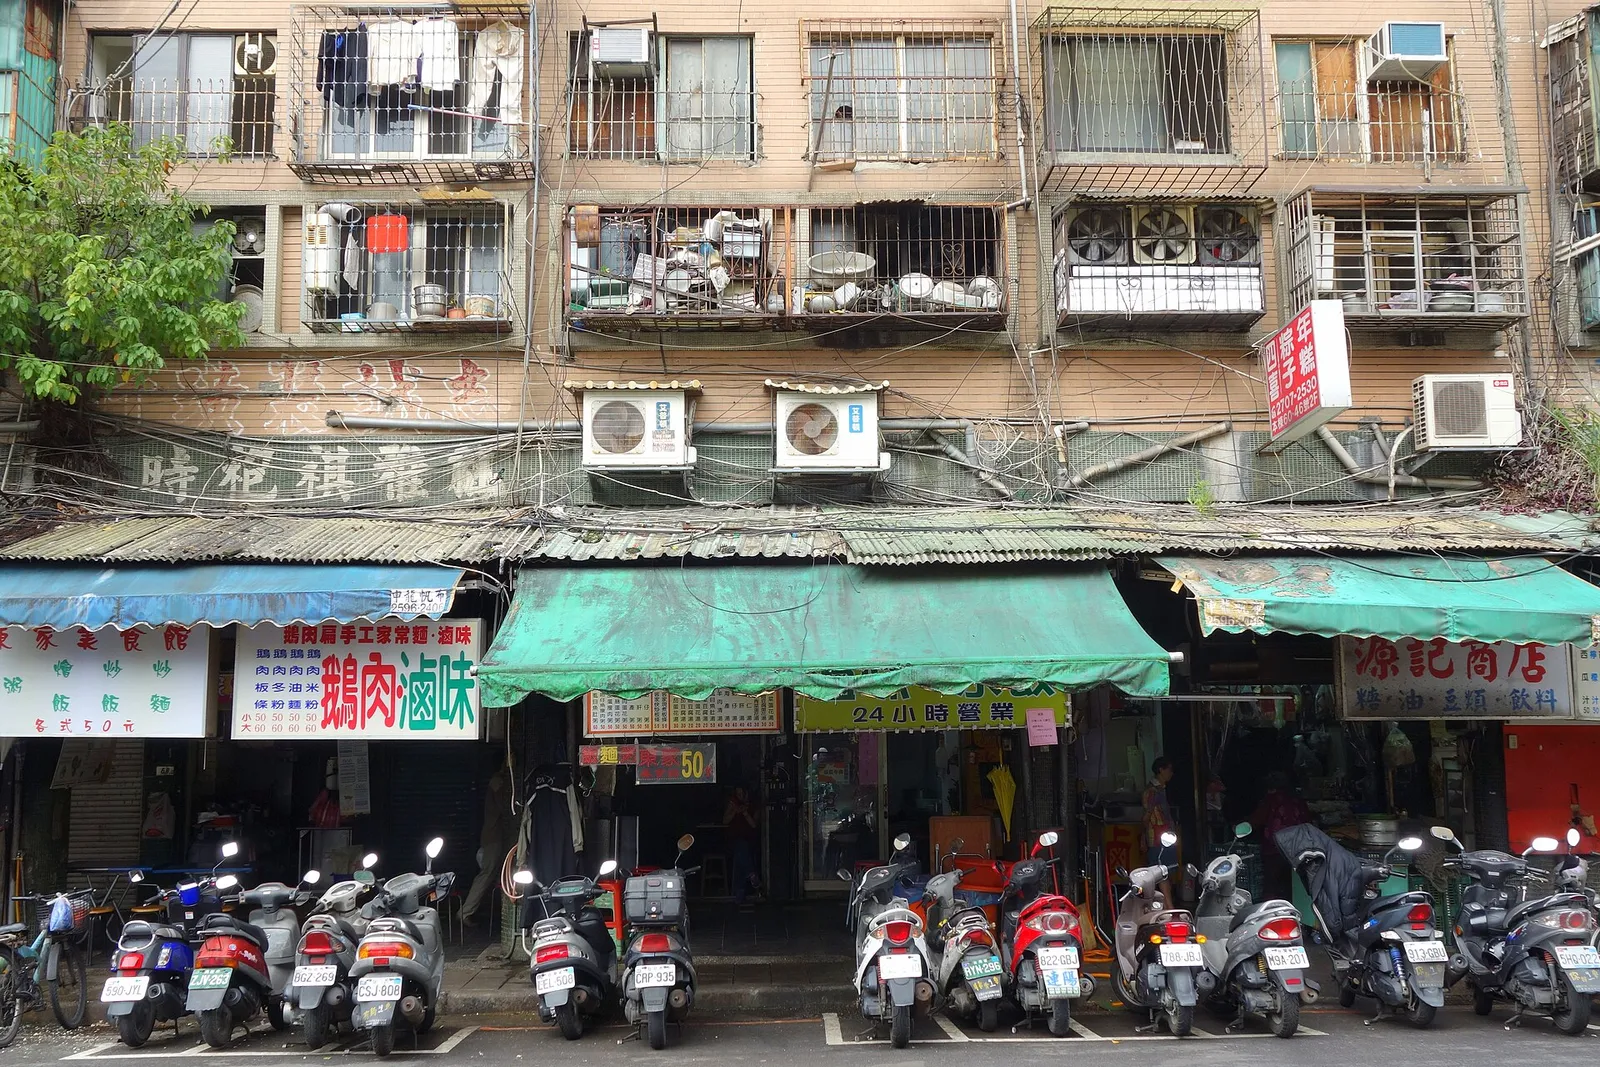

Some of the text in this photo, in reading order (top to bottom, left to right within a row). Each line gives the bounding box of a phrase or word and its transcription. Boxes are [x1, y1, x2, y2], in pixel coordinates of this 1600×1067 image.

[1296, 312, 1316, 376] 年糕
[1278, 327, 1296, 389] 粽子
[1265, 340, 1280, 402] 四喜
[1274, 376, 1317, 416] 2707-2530
[1355, 636, 1547, 683] 源記商店
[102, 659, 122, 713] 炒飯
[150, 659, 172, 713] 炒麵
[241, 713, 317, 722] 小 50 50 50 50
[853, 702, 1014, 723] 24小時營業
[35, 718, 135, 733] 各式50元
[241, 724, 317, 733] 大 60 60 60 60
[681, 750, 704, 778] 50
[1040, 953, 1078, 966] 822-GBJ
[1163, 951, 1202, 963] 788-JBJ
[1407, 947, 1446, 959] 913-GBU
[635, 971, 675, 985] CAP-935
[105, 983, 142, 996] 590-JYL
[358, 985, 400, 997] CSJ-808
